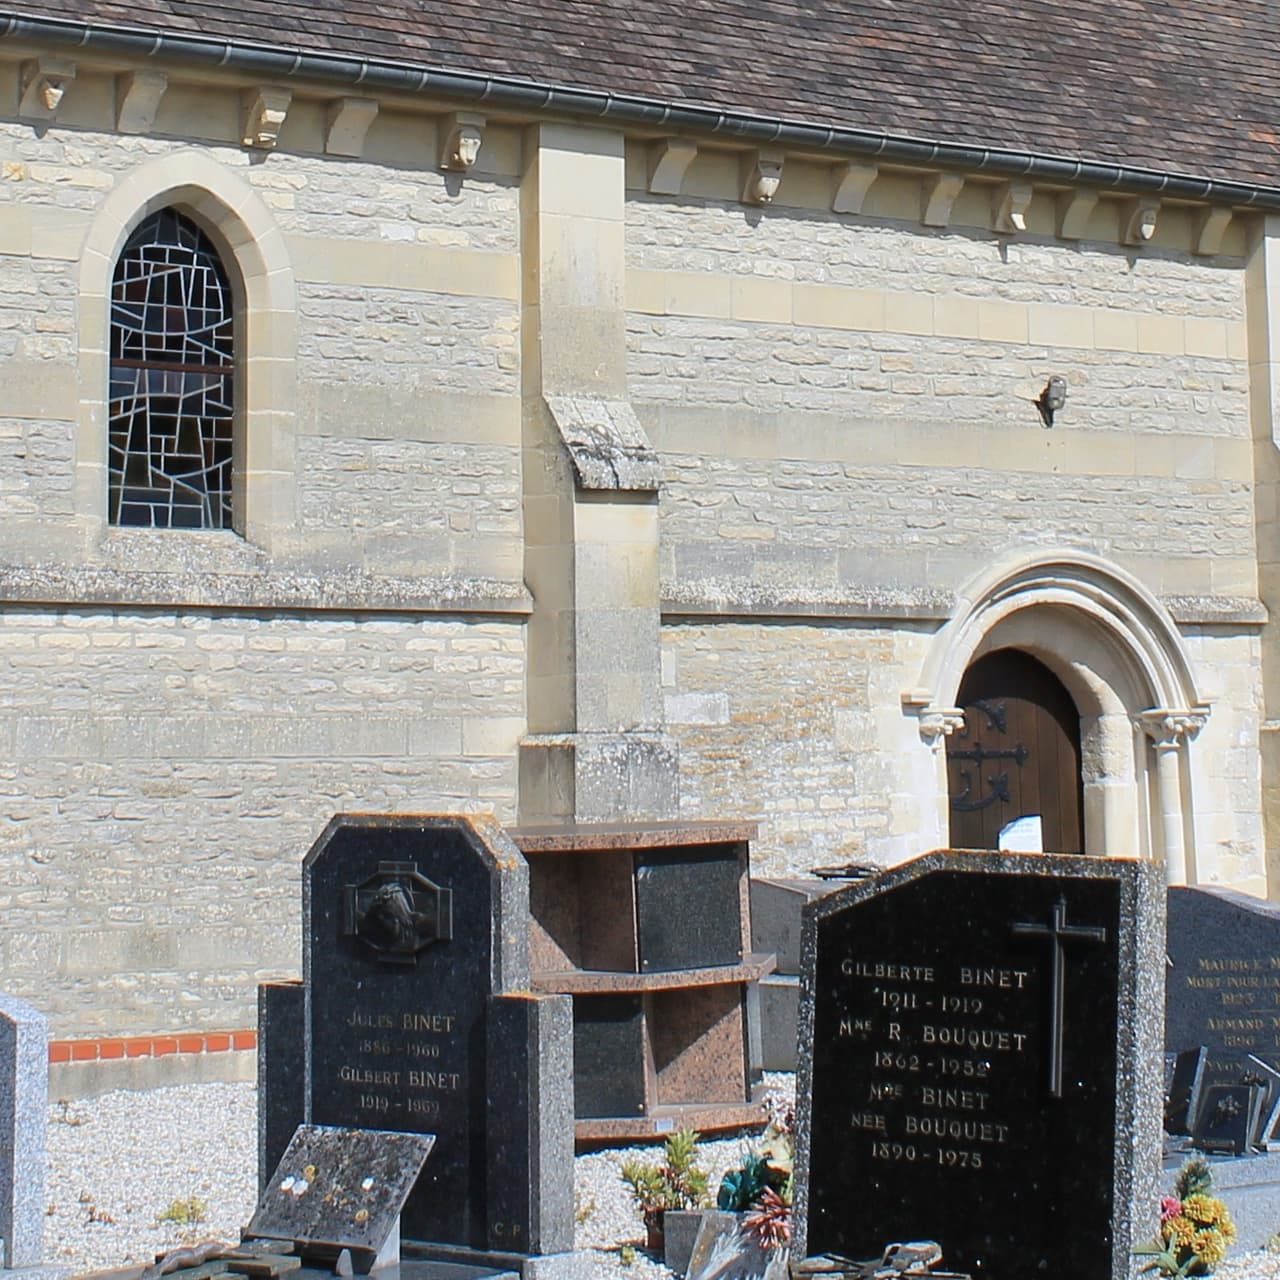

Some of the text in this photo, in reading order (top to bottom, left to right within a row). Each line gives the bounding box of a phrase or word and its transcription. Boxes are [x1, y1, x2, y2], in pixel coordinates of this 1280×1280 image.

[841, 958, 1028, 989] GILBERTE BINET
[1199, 958, 1263, 972] MAURICE
[347, 1010, 455, 1033] JULES BINET
[1207, 1018, 1265, 1032] ARMAND
[889, 1022, 901, 1040] R
[923, 1024, 1026, 1051] BOUQUET
[340, 1065, 460, 1090] GILBERT BINET
[922, 1087, 989, 1112] BINET
[905, 1117, 1009, 1143] BOUQUET
[938, 1148, 983, 1169] 1975
